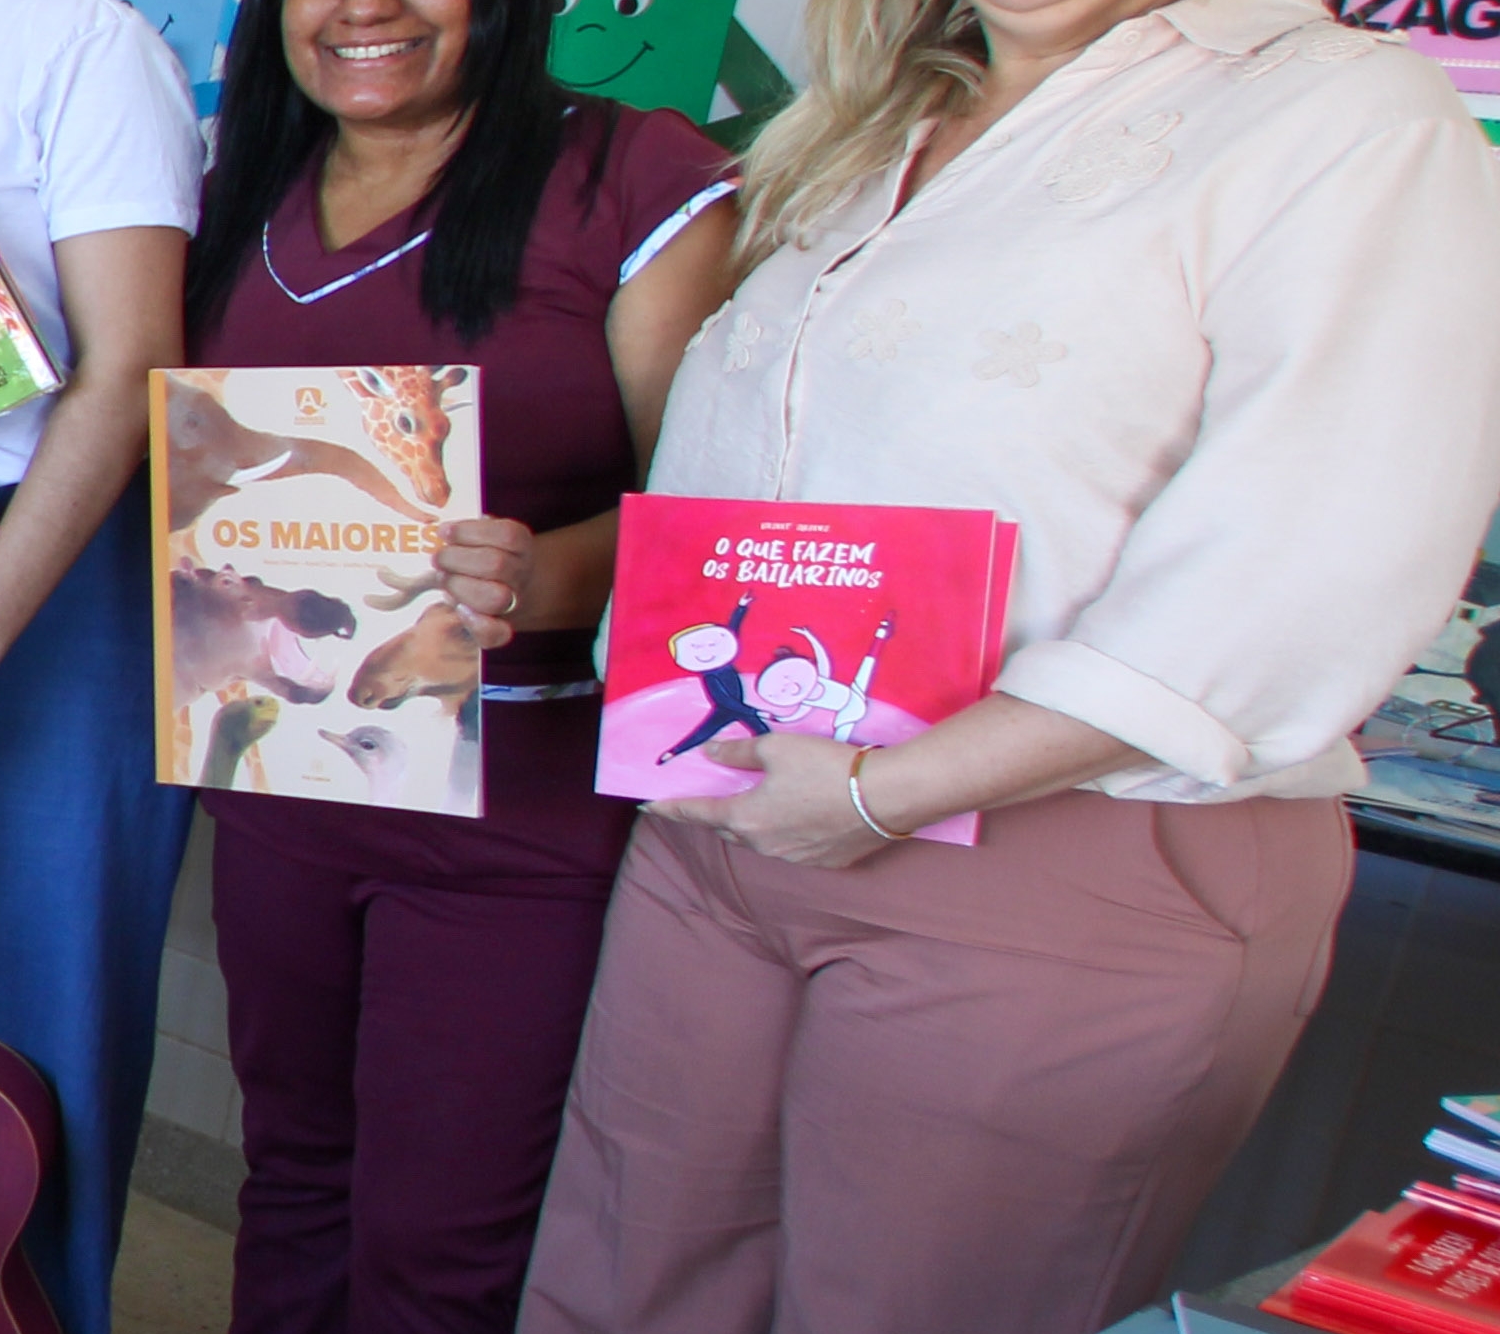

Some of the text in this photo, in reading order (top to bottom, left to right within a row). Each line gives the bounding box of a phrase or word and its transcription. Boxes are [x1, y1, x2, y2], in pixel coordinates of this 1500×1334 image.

[213, 520, 445, 555] OS MAIORES
[715, 537, 876, 564] O QUE FAZEM
[702, 559, 882, 588] OS BAILARINOS
